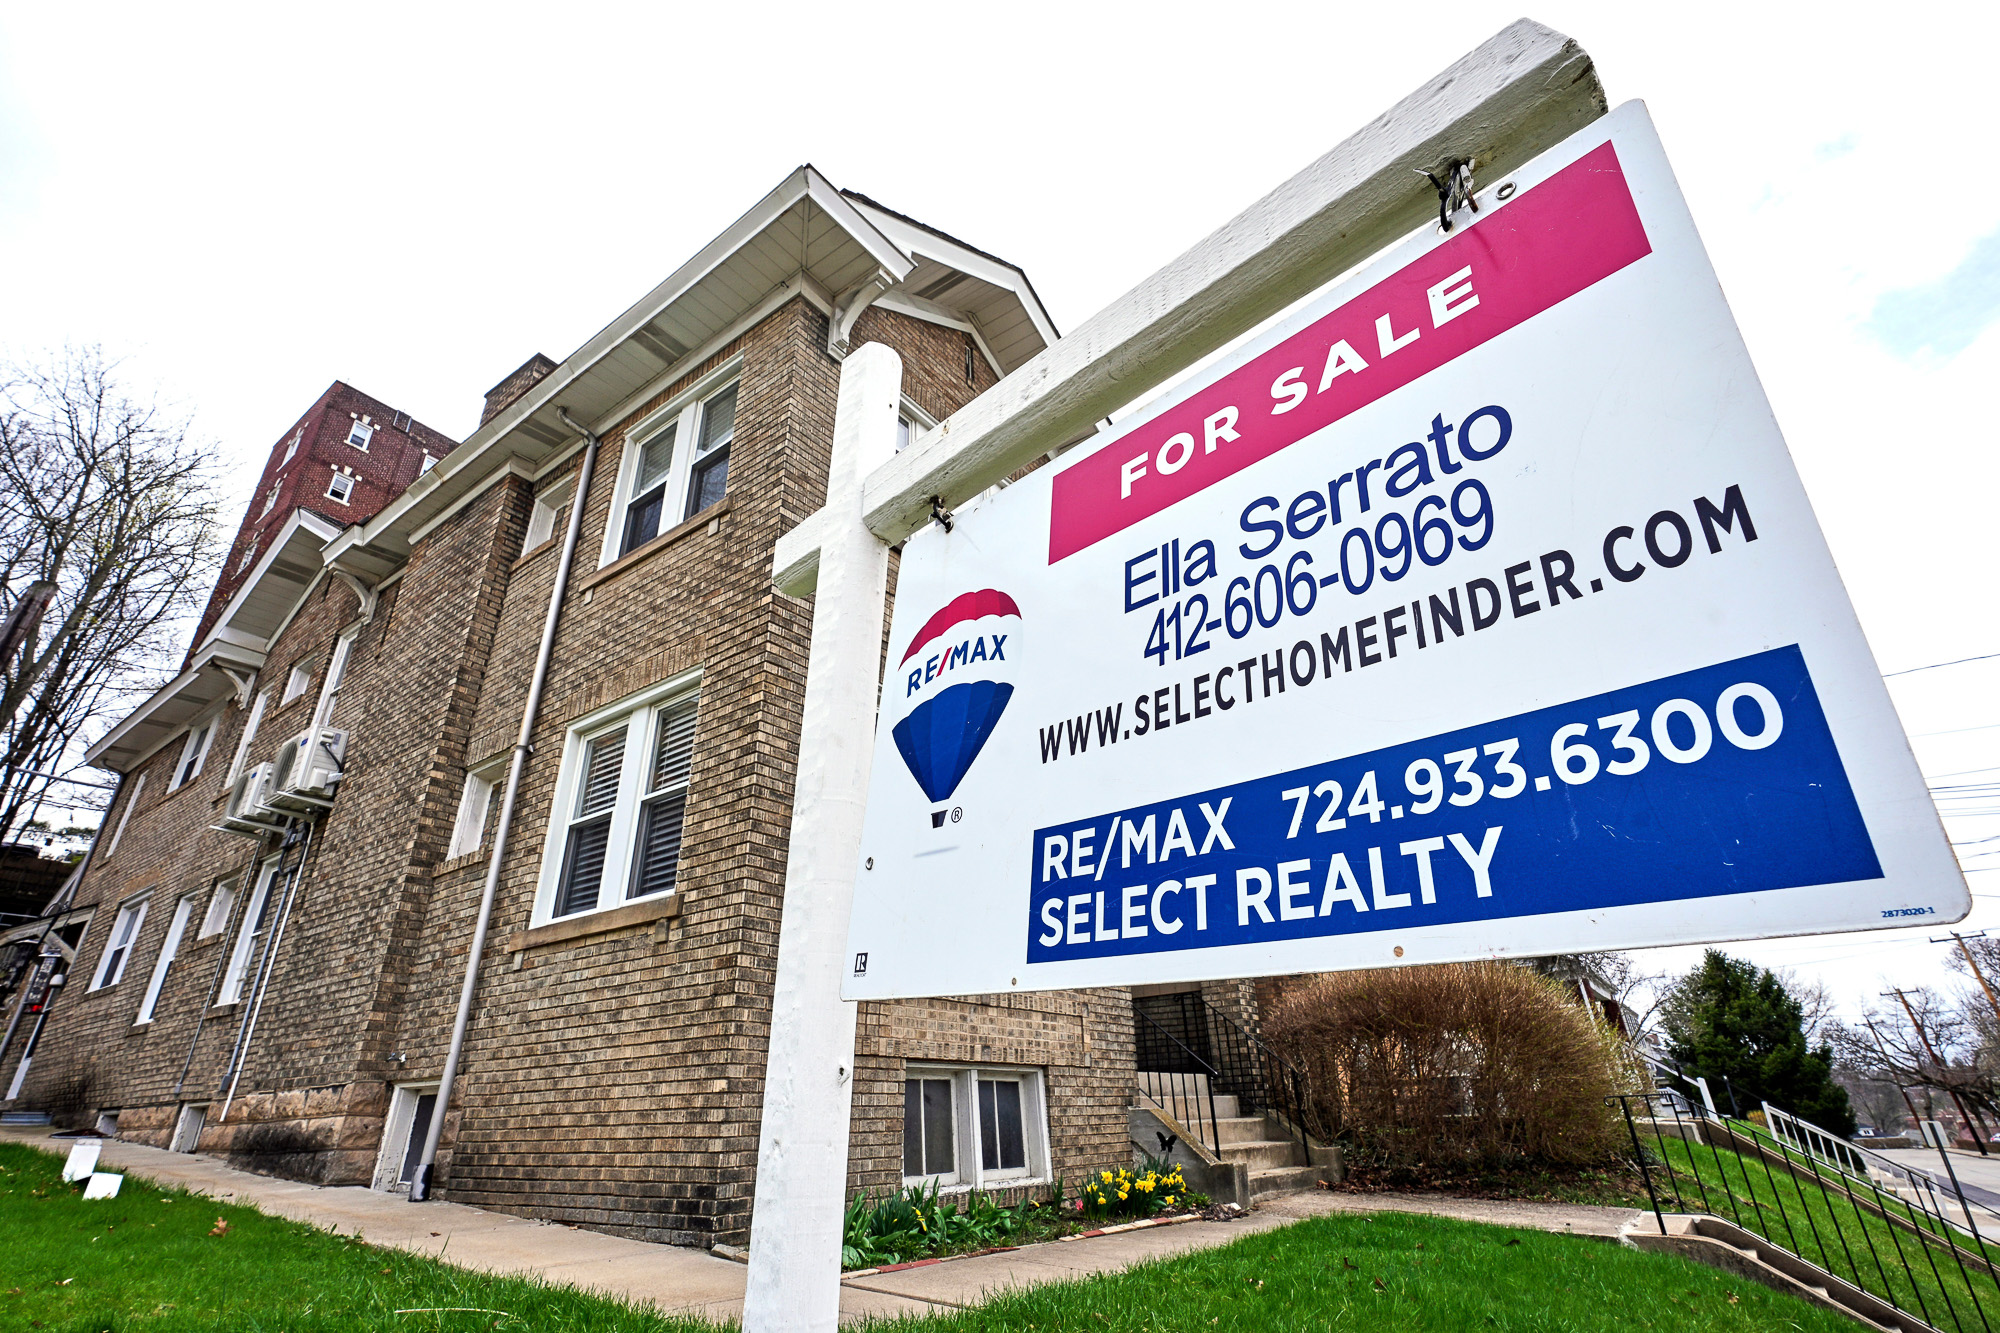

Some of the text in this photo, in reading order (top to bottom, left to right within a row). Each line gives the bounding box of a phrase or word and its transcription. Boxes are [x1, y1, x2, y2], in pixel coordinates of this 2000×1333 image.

[1120, 264, 1481, 500] FOR SALE
[1124, 404, 1513, 615] Ella Serrato
[1143, 477, 1495, 667] 412-606-0969
[906, 634, 1008, 699] RE/MAX
[1039, 483, 1759, 765] WWW.SELECTHOMEFINDER.COM
[1042, 682, 1785, 883] RE/MAX 724.933.6300
[1038, 825, 1504, 949] SELECT REALTY
[1880, 906, 1936, 918] 2873020-1
